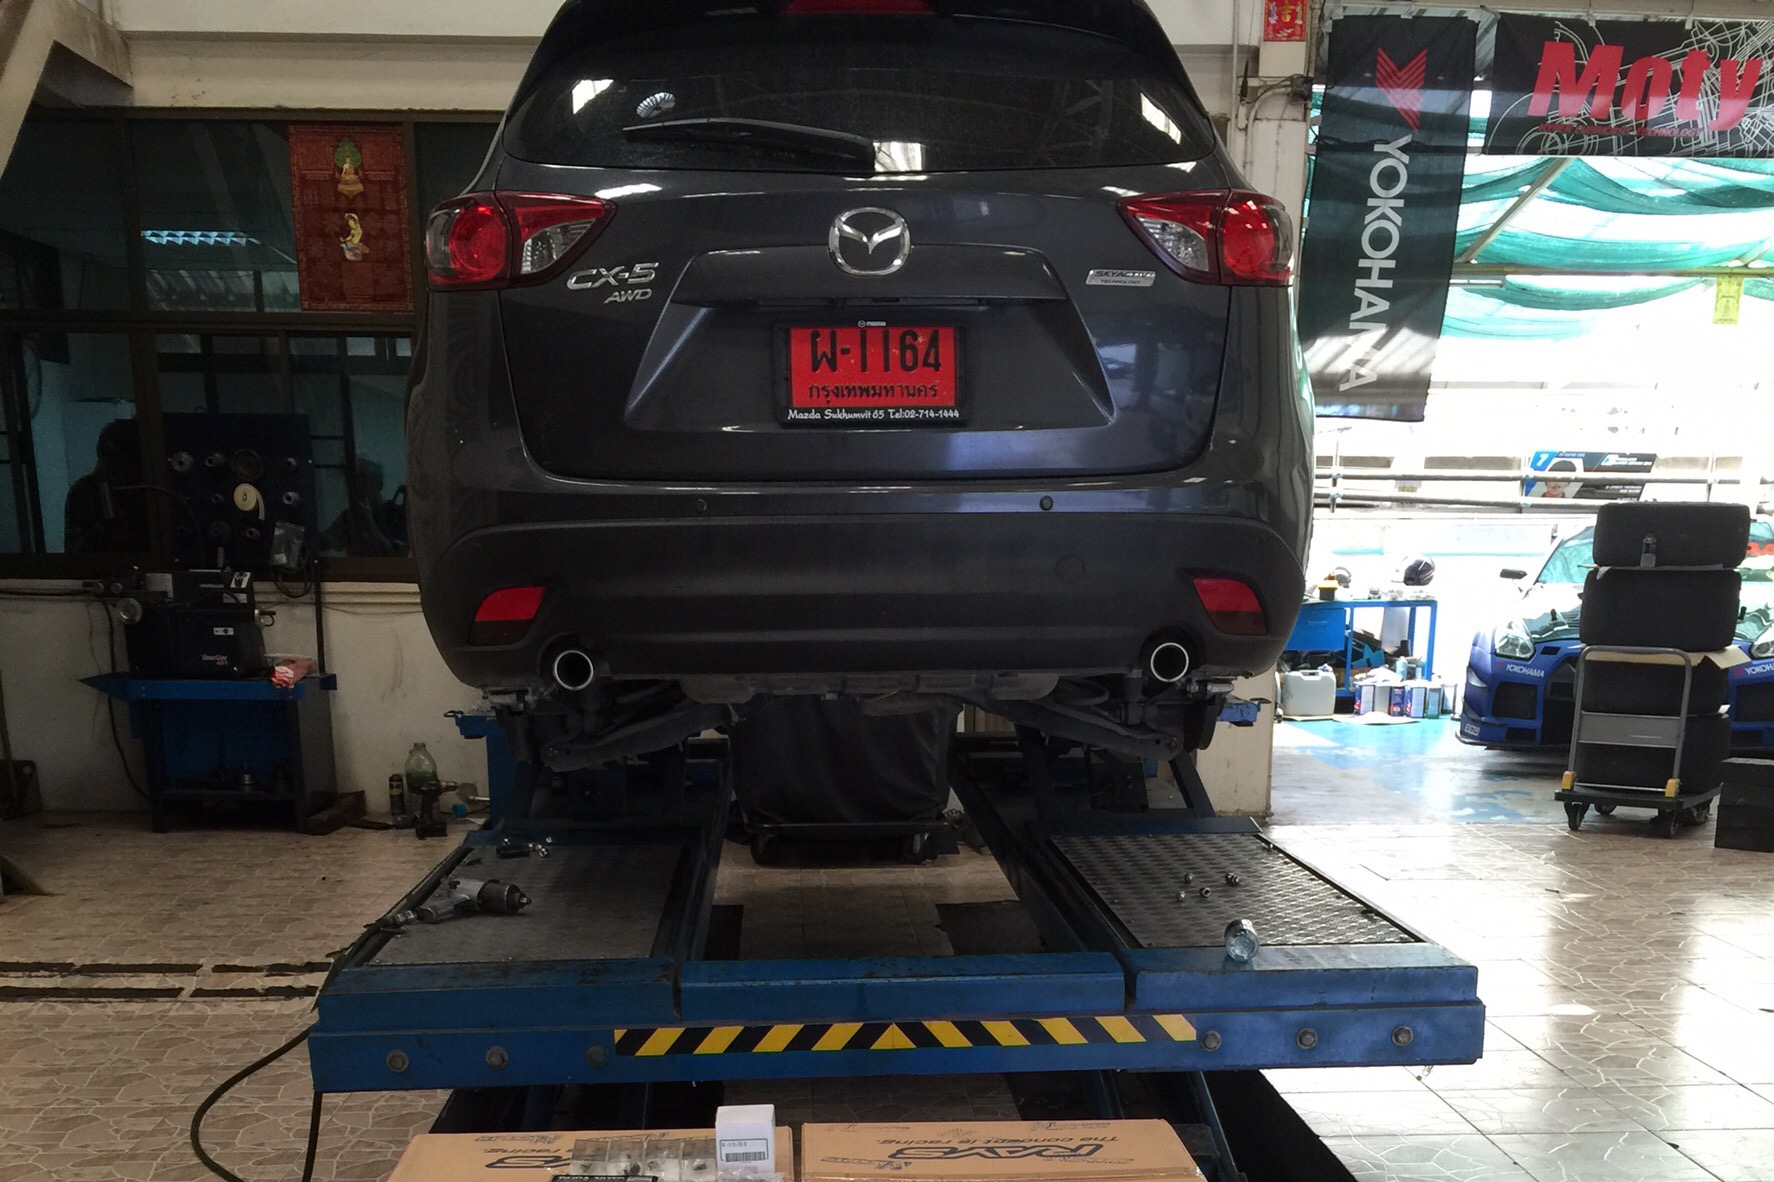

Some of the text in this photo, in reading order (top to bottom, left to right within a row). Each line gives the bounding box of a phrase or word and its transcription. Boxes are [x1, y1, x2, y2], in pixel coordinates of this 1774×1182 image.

[1527, 40, 1774, 132] Moty
[566, 261, 660, 290] CX-5
[602, 288, 653, 305] AWD
[808, 383, 939, 405] กรุงเทพมหานคร
[787, 408, 961, 421] Mazda Sukhumvit 65 Tel:02-714-1444
[1504, 662, 1545, 678] YOKOHAMA
[1744, 662, 1774, 676] YOKOH
[888, 1143, 1104, 1159] RAYS
